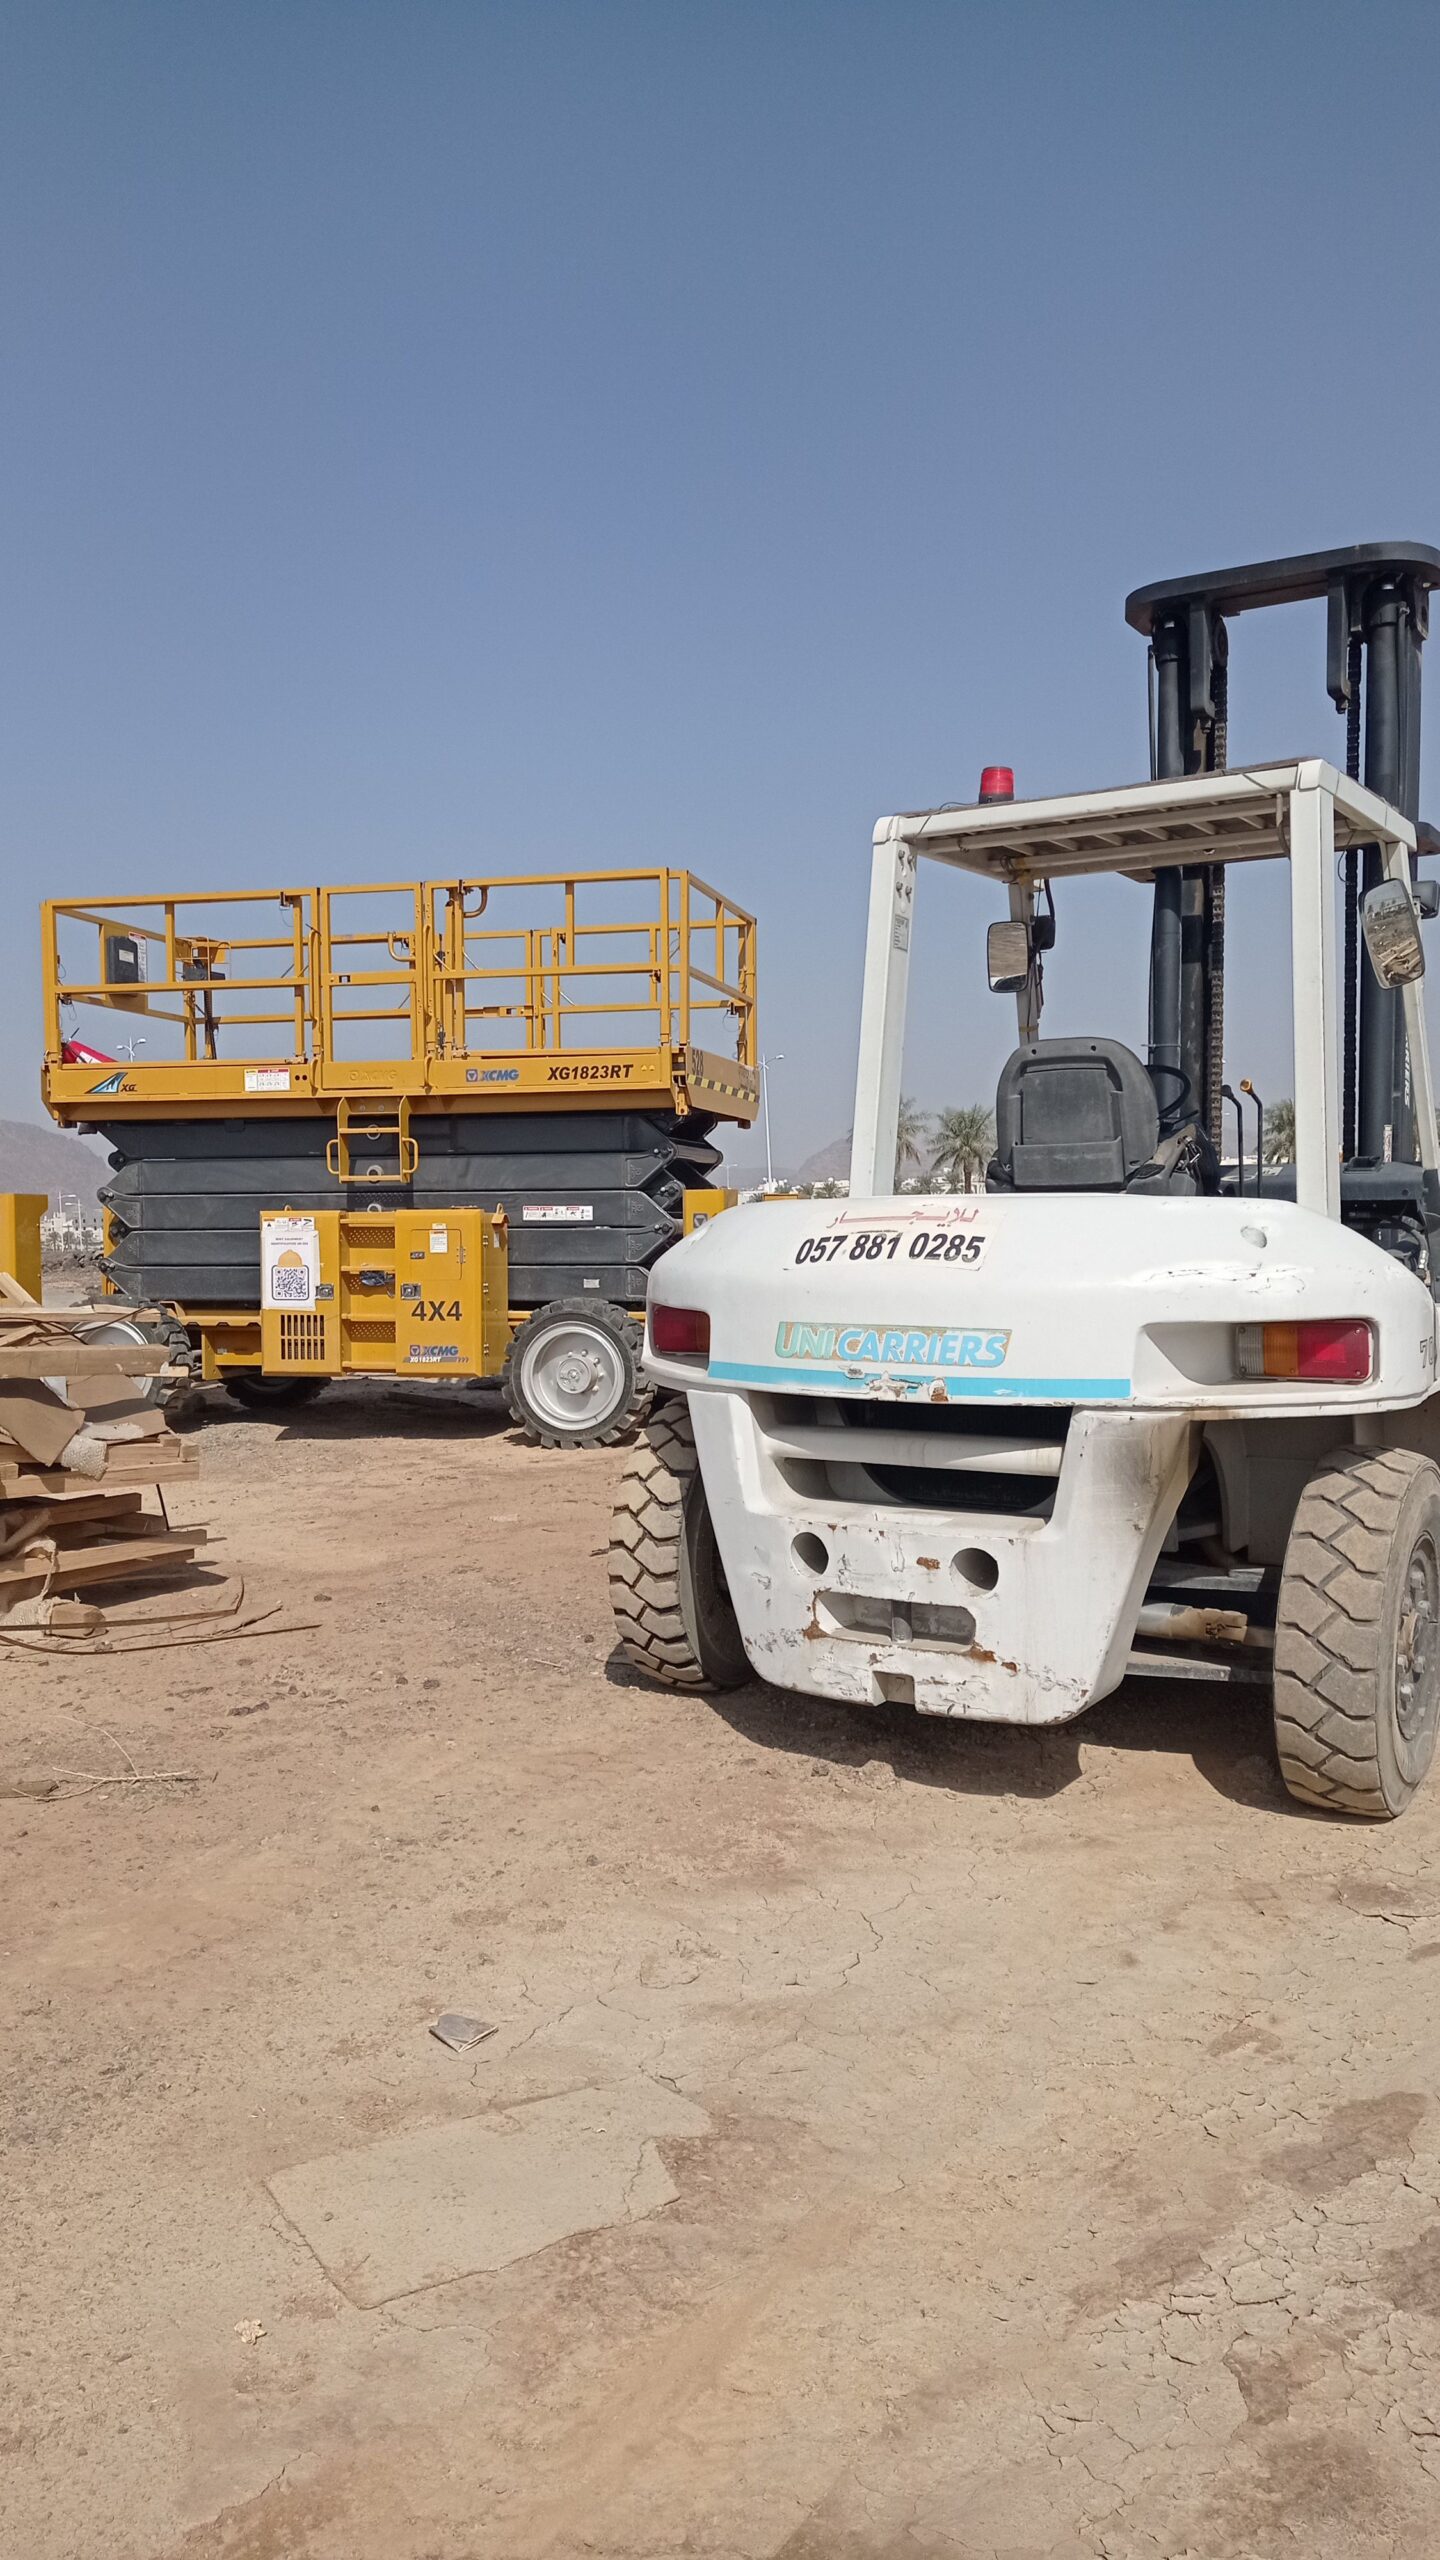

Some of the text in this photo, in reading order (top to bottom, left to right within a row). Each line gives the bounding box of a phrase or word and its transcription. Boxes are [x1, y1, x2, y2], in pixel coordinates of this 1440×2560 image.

[481, 1064, 633, 1081] XCMG XG1823RT
[795, 1232, 986, 1264] 057 881 0285
[411, 1300, 462, 1321] 4X4
[422, 1345, 459, 1356] XCMG
[774, 1322, 1010, 1367] UNICARRIERS
